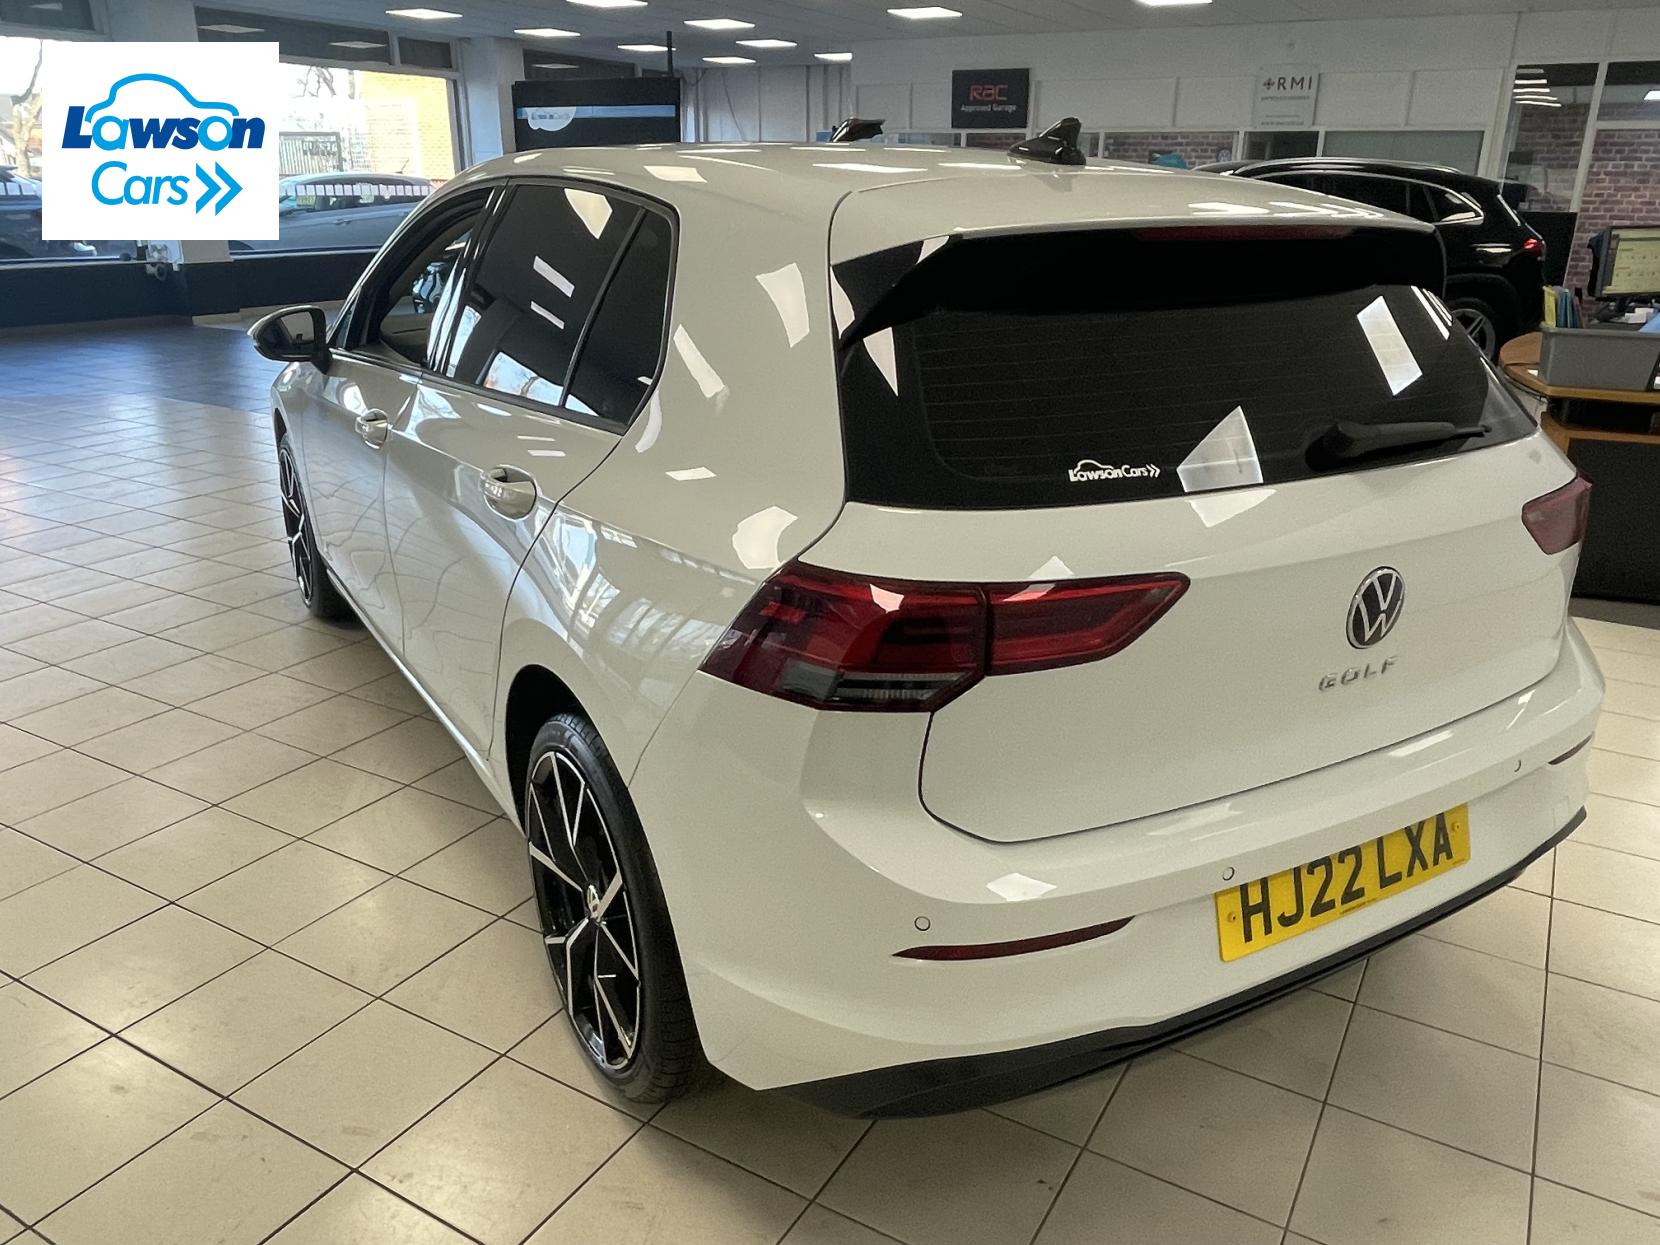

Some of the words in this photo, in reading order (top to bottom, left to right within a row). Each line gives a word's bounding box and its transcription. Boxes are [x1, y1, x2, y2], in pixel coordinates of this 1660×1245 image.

[1277, 76, 1312, 91] RMI
[1319, 656, 1398, 691] GOLF
[1240, 846, 1365, 943] HJ22
[1376, 812, 1453, 889] LXA
